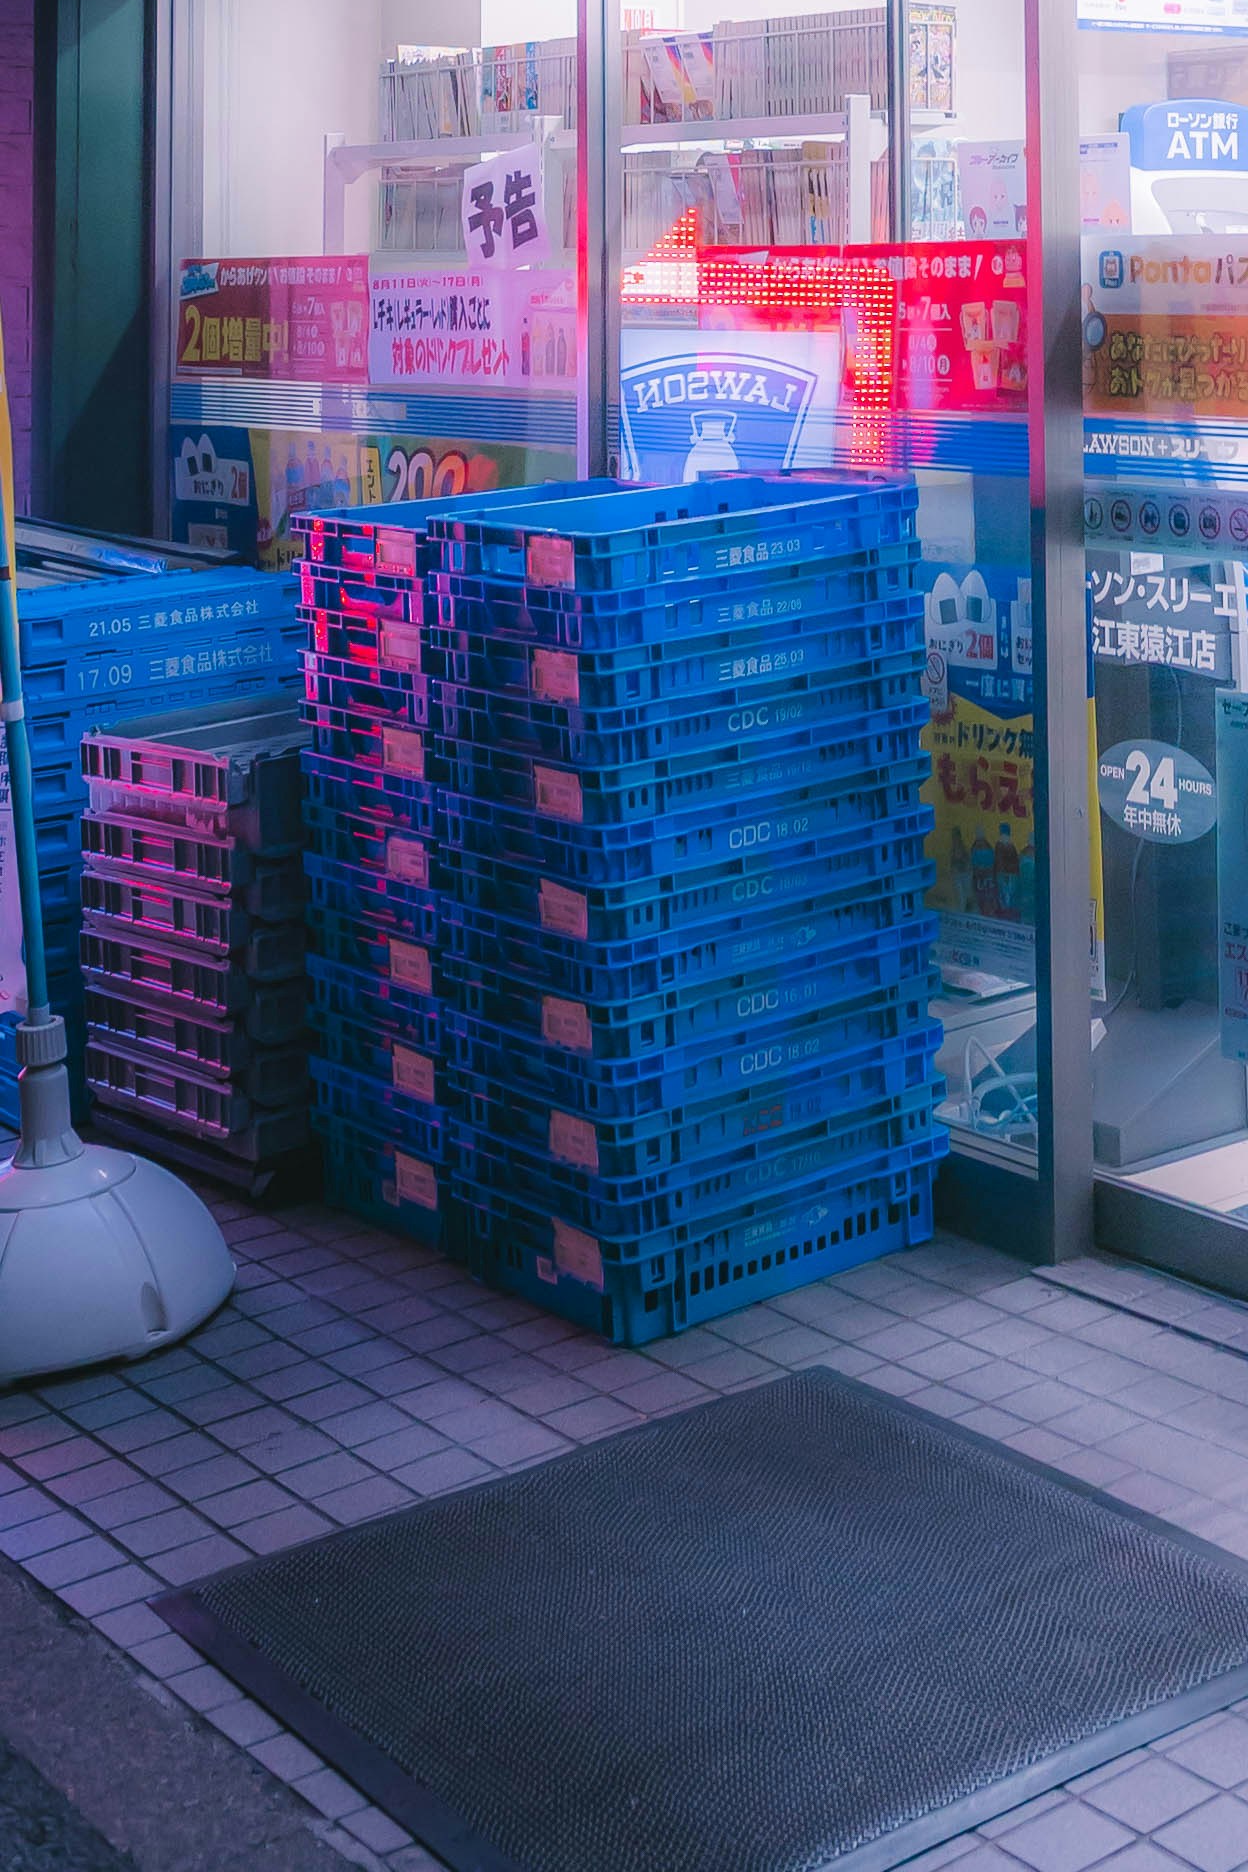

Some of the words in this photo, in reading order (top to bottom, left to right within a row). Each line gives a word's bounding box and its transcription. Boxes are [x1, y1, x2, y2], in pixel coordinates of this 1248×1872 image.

[1166, 111, 1240, 130] ローソン銀行
[1167, 131, 1239, 161] ATM
[467, 169, 539, 260] 予告
[181, 304, 290, 365] 2個増量中!
[714, 542, 770, 569] 三菱食品
[88, 617, 132, 638] 21.05
[137, 599, 260, 631] 三菱食品株式会社
[716, 598, 774, 623] 三菱食品
[927, 637, 964, 662] おにぎり
[964, 629, 995, 661] 2個
[1091, 615, 1217, 671] 江東猿江店
[77, 664, 133, 694] 17.09
[148, 641, 274, 682] 三菱食品株式会社
[718, 653, 773, 682] 三菱食品
[727, 706, 769, 733] CDC
[935, 752, 1034, 819] もらえ
[1100, 764, 1126, 780] OPEN
[1125, 749, 1179, 811] 24
[1178, 778, 1213, 797] HOURS
[728, 821, 771, 850] CDC
[1122, 806, 1182, 837] 年中無休
[732, 875, 774, 902] CDC
[736, 988, 779, 1018] CDC
[740, 1044, 783, 1076] CDC
[744, 1157, 786, 1186] CDC
